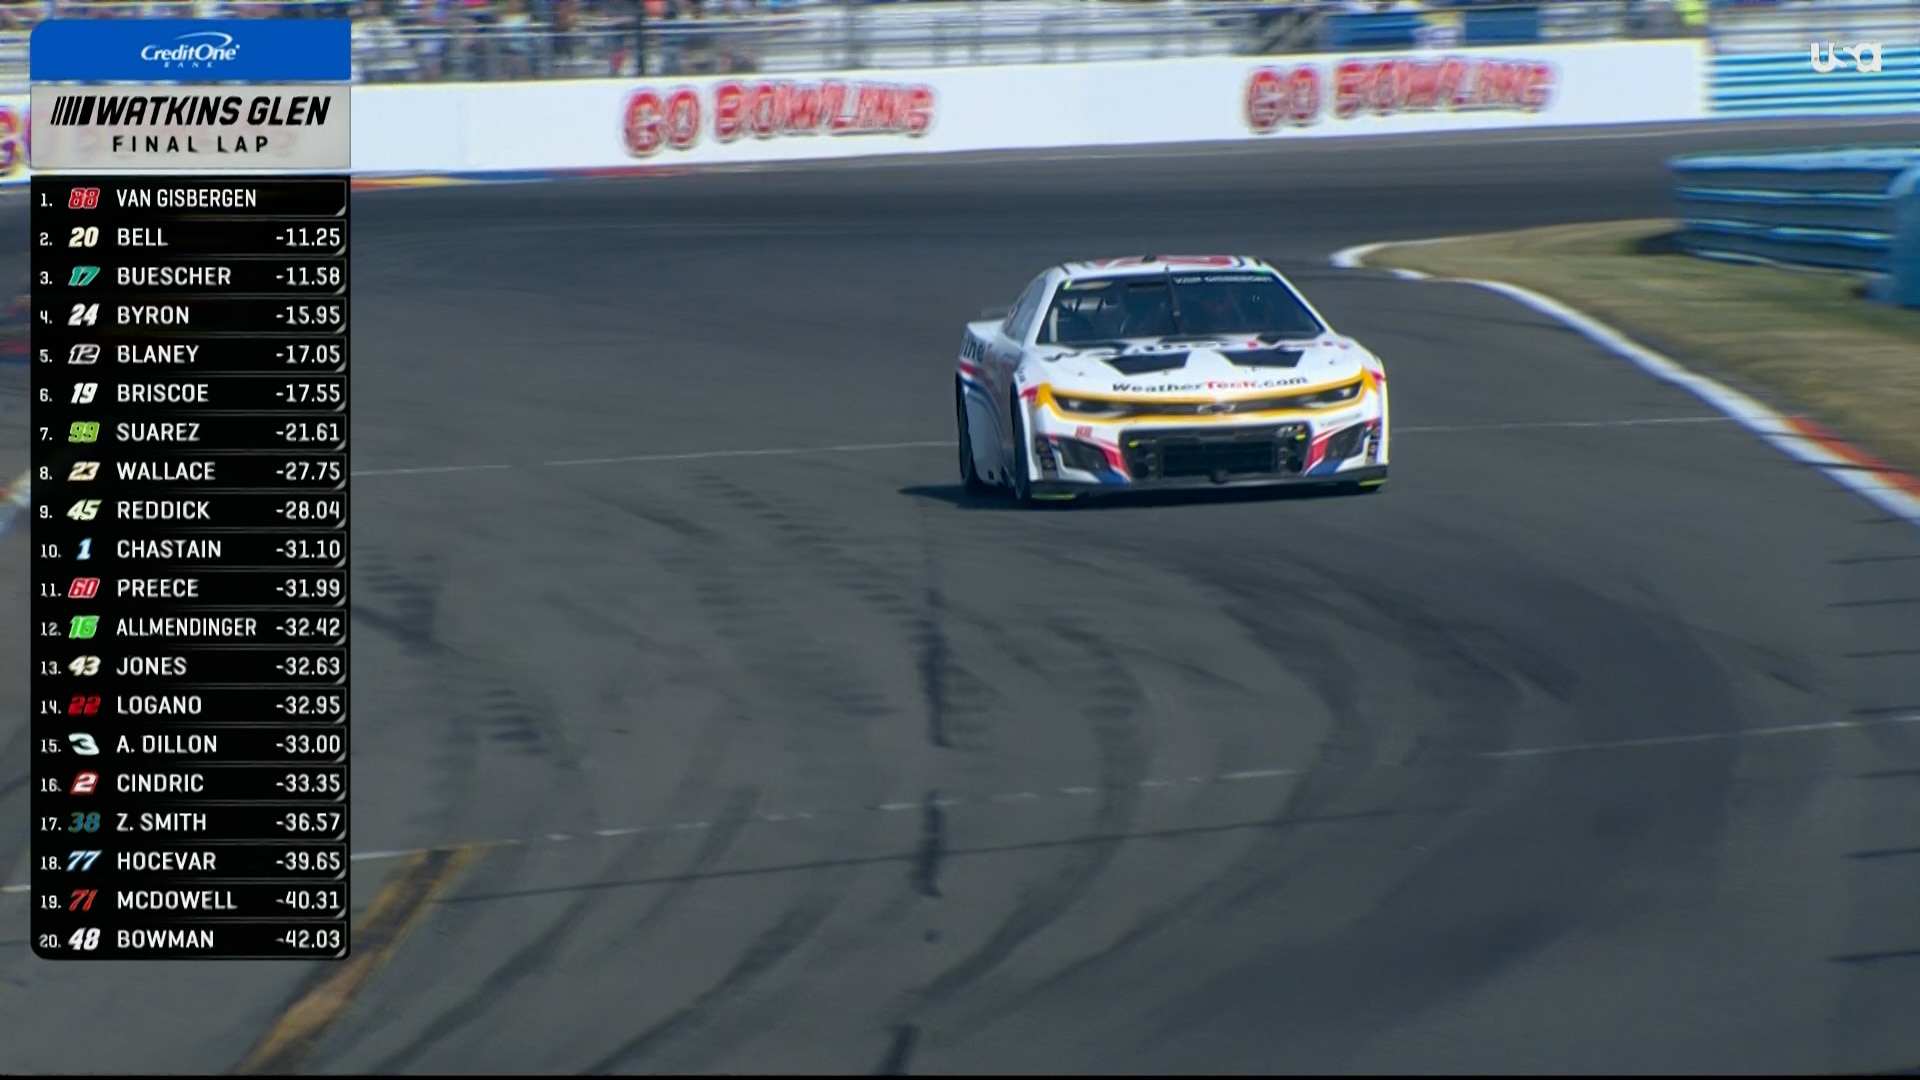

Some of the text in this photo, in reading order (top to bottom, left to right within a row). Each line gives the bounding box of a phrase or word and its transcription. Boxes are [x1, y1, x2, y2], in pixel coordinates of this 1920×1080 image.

[624, 80, 935, 155] GO BOWLING
[1247, 57, 1554, 132] GO BOWLING
